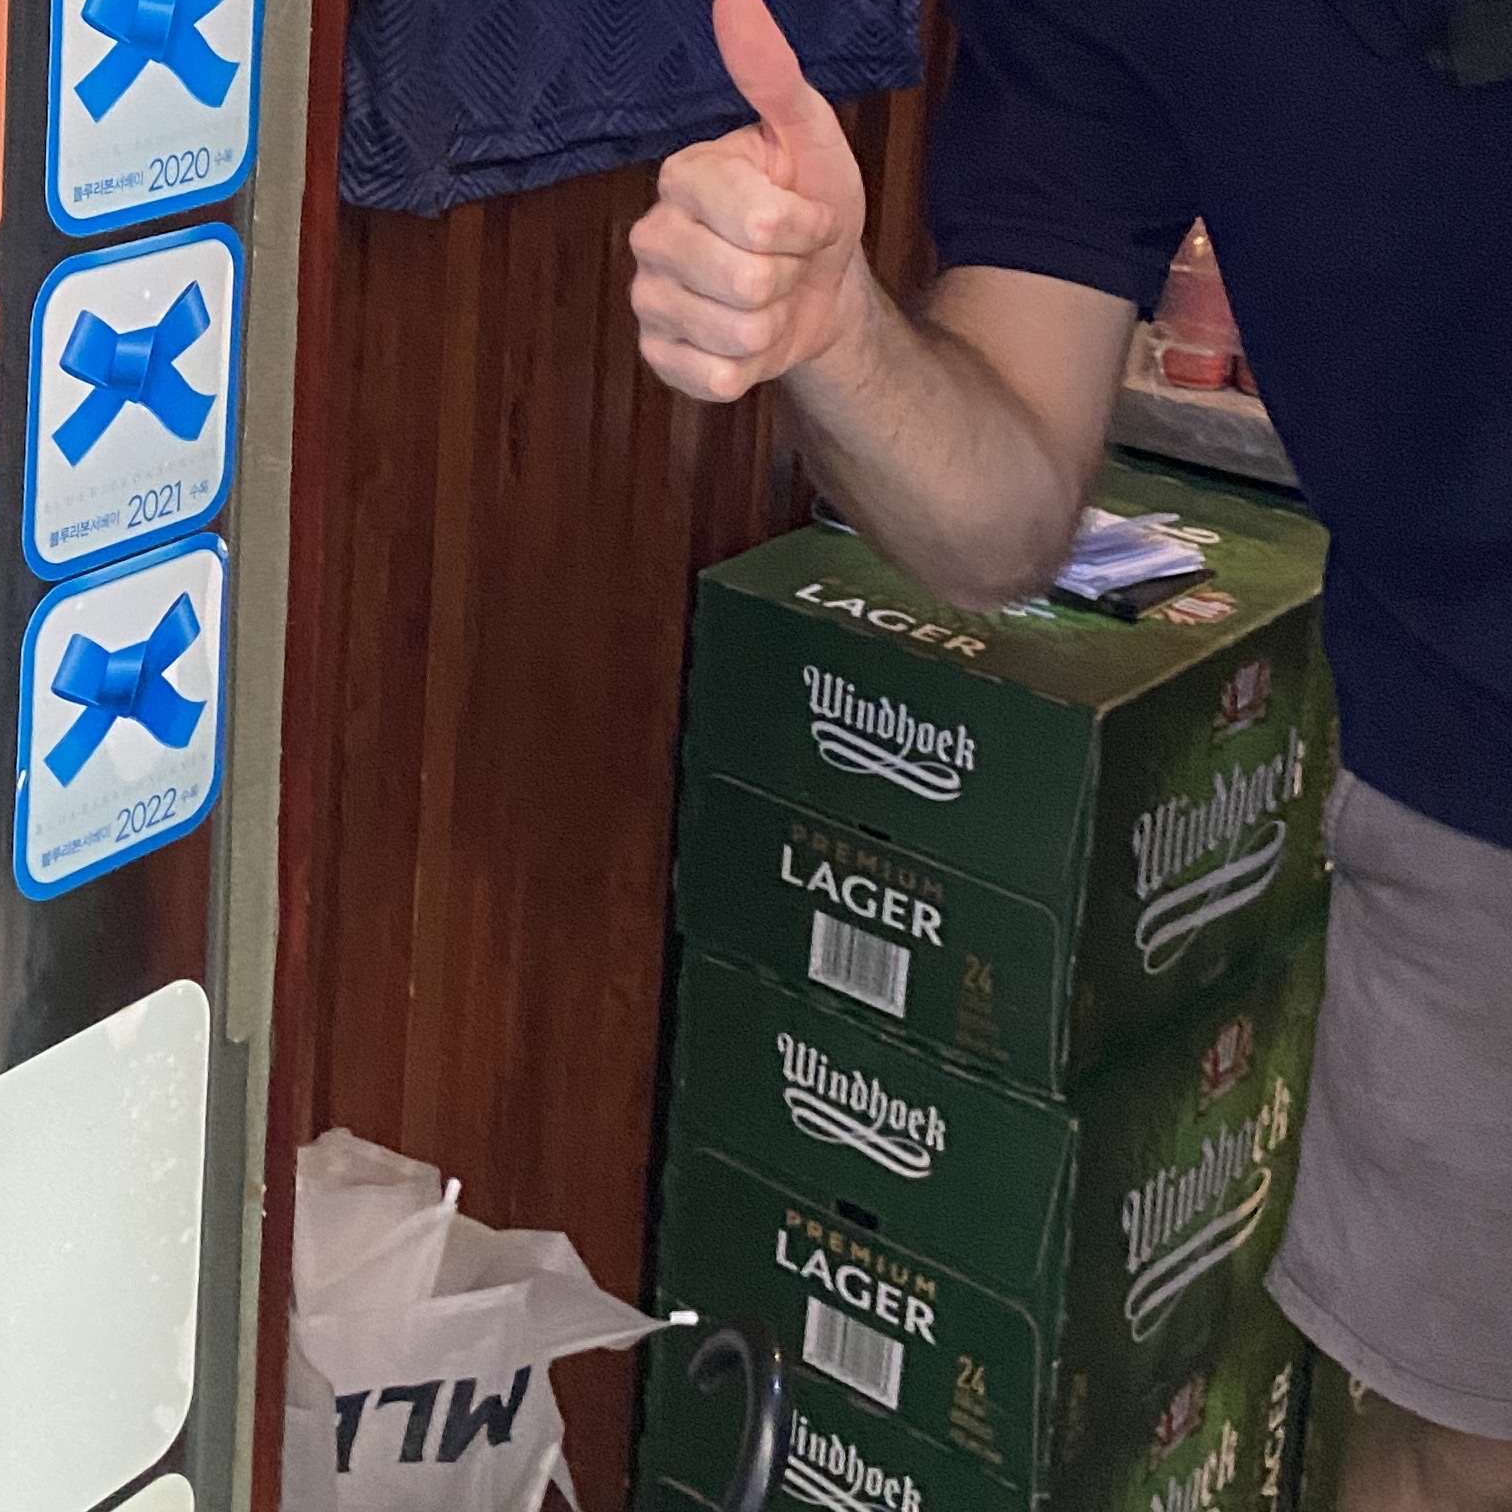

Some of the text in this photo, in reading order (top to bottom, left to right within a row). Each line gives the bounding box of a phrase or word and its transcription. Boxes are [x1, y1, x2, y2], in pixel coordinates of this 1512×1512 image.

[148, 147, 210, 192] 2020
[127, 480, 182, 529] 2021
[794, 583, 986, 658] LAGER
[803, 665, 978, 771] Windhoek
[115, 787, 177, 843] 2022
[781, 844, 944, 947] LAGER
[777, 1032, 946, 1151] Windhoek
[776, 1228, 936, 1345] LAGER
[786, 1209, 937, 1300] PREMIUM
[790, 1409, 921, 1512] indhoek
